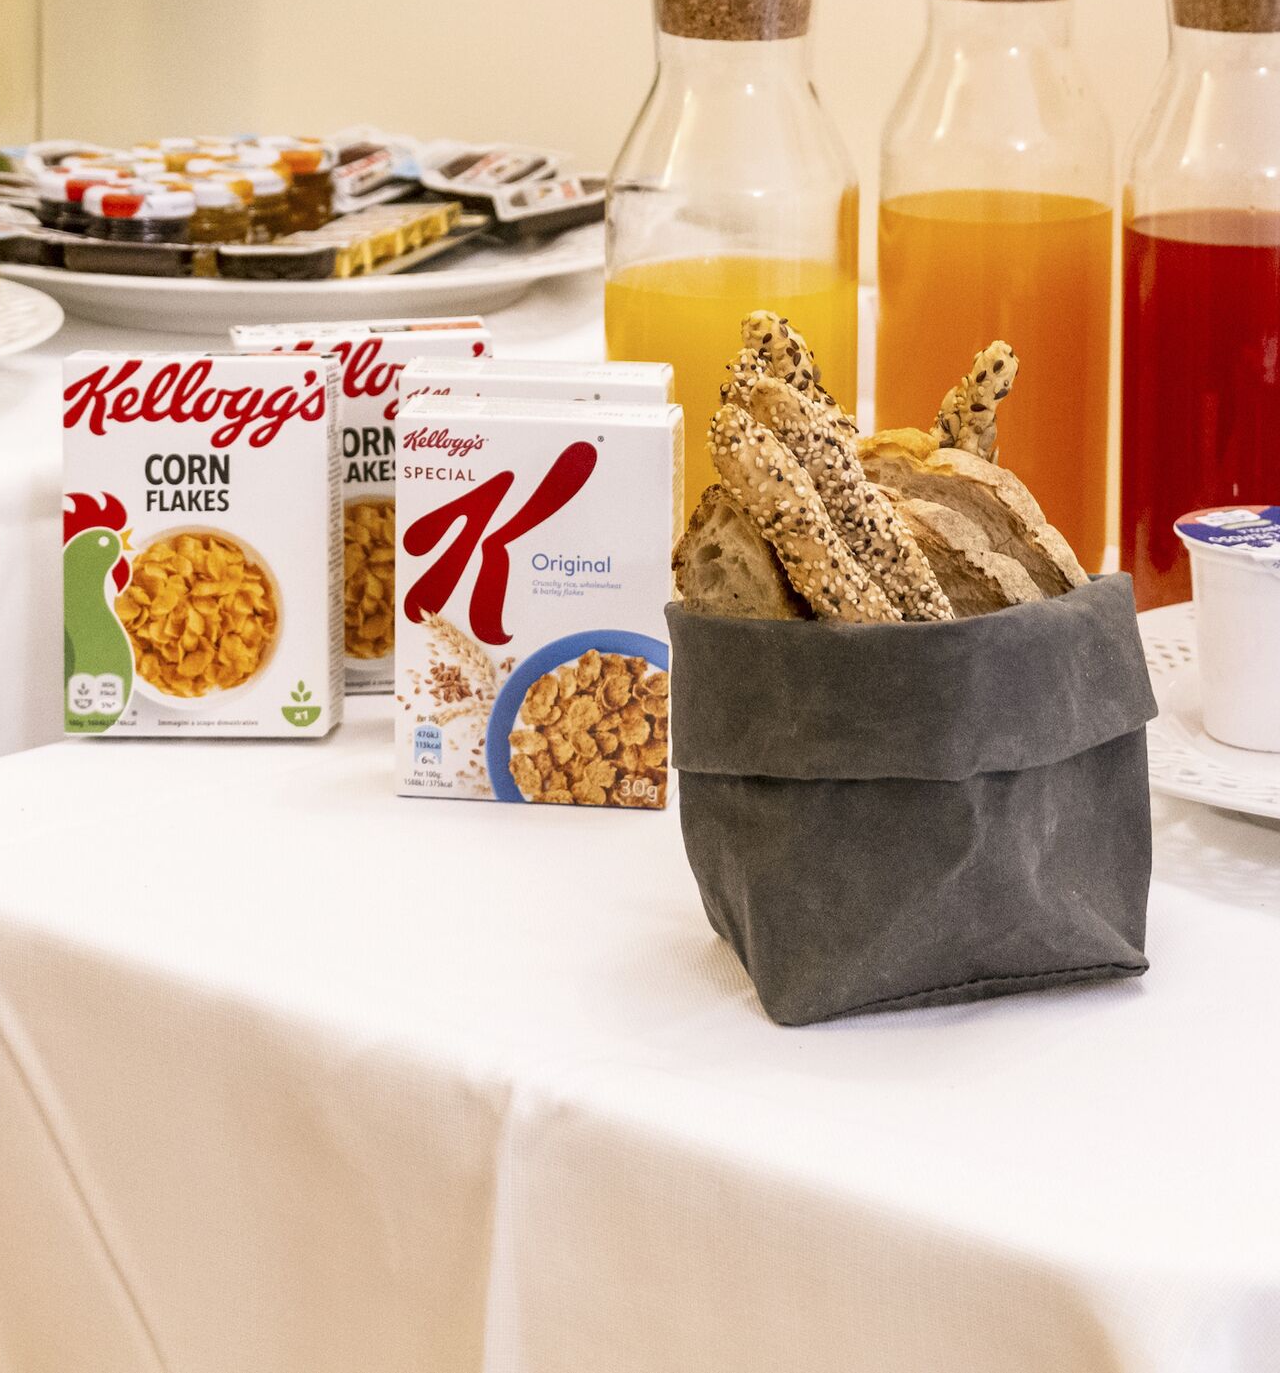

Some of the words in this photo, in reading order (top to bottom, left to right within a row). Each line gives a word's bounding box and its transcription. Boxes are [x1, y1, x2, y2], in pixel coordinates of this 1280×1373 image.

[63, 359, 326, 448] Kellogg's
[343, 426, 395, 458] ORN
[403, 426, 485, 457] Kellogg's
[144, 453, 231, 485] CORN
[343, 460, 395, 483] AKE
[404, 466, 476, 482] SPECIAL
[146, 490, 230, 512] FLAKES
[403, 440, 599, 646] K
[531, 553, 611, 577] Original
[532, 580, 562, 589] Crunchy
[580, 581, 622, 590] wholewheat
[563, 589, 585, 597] flakes
[620, 779, 658, 801] 30g
